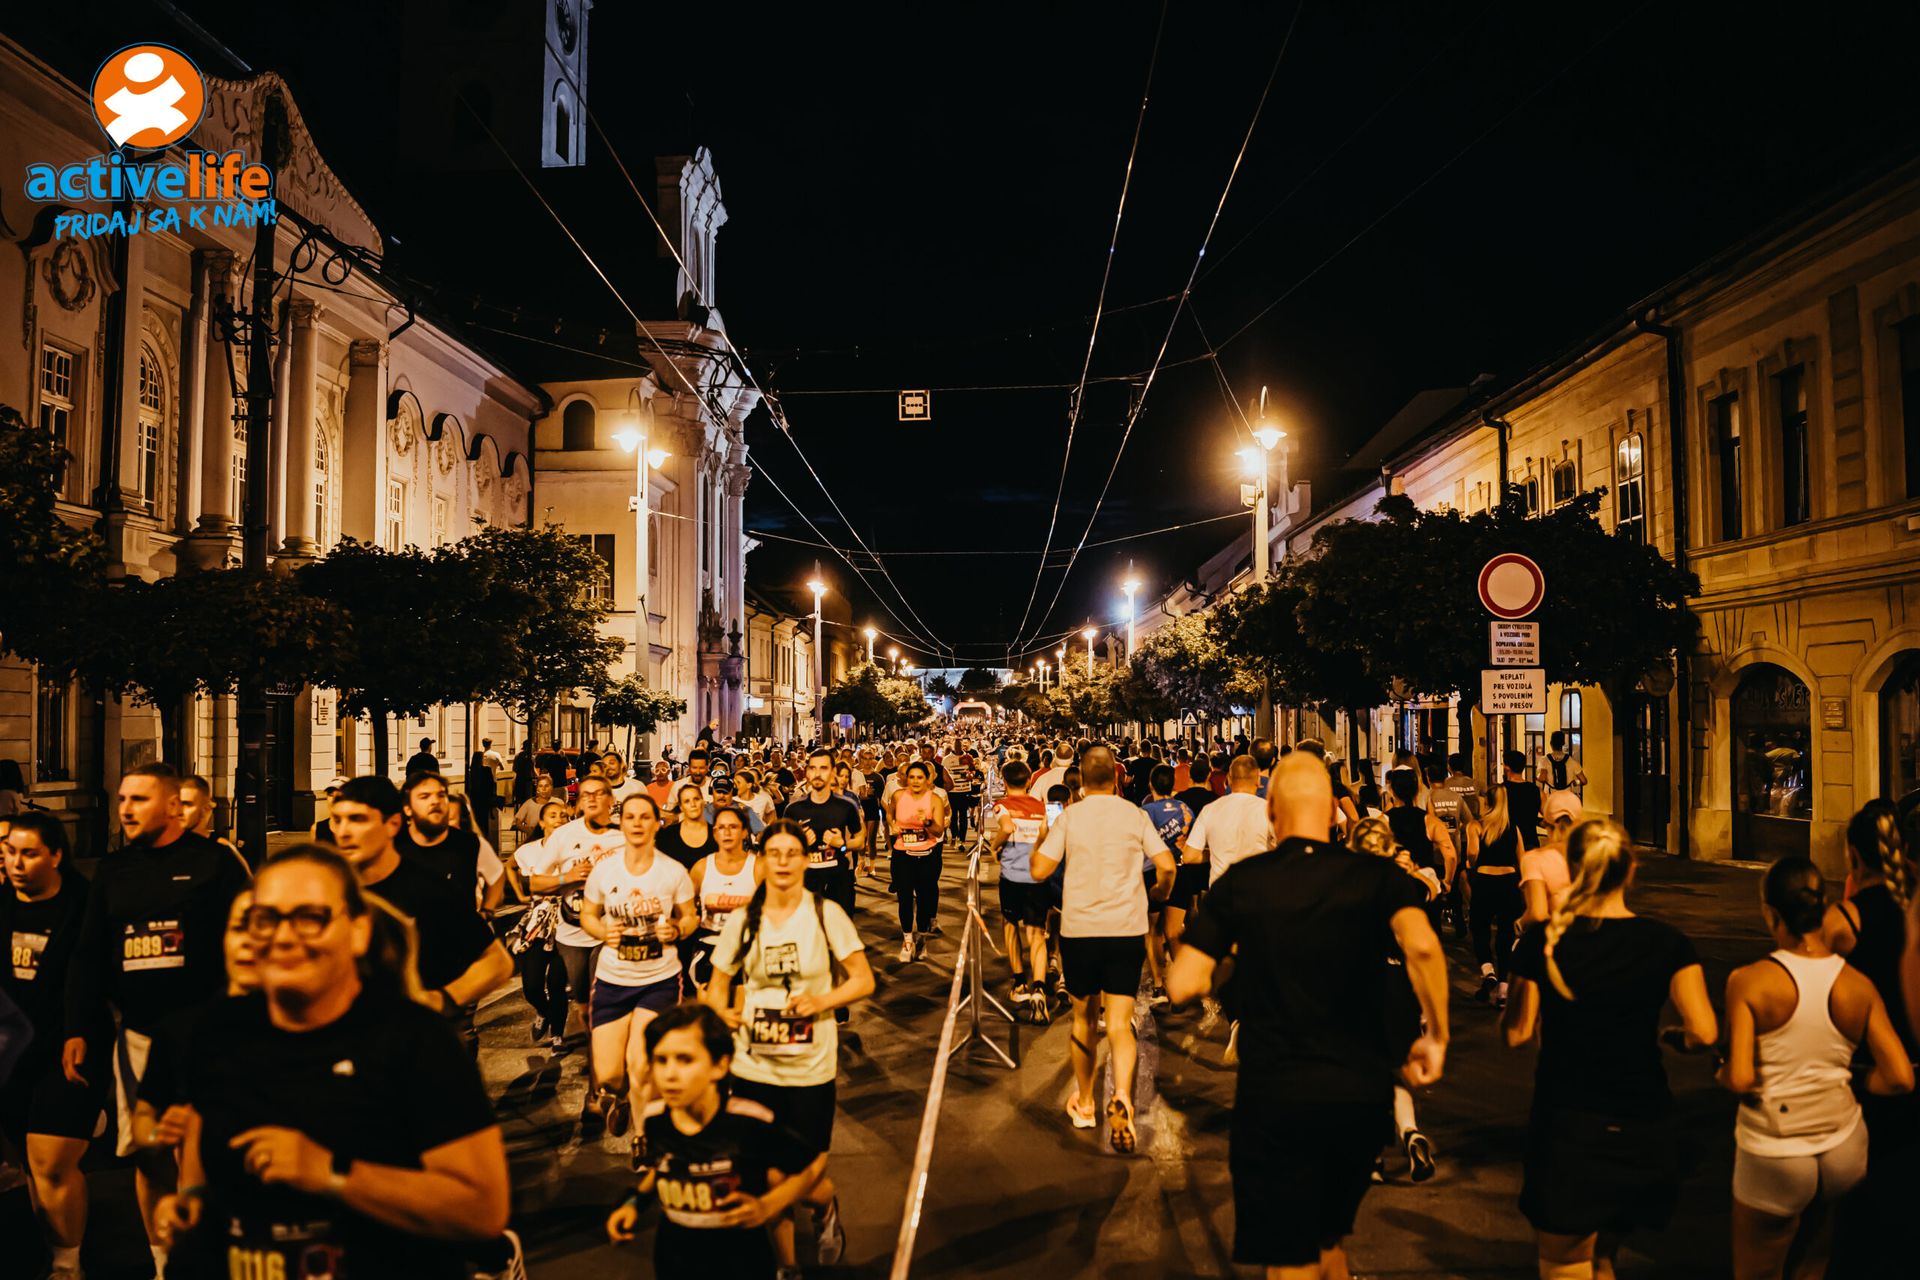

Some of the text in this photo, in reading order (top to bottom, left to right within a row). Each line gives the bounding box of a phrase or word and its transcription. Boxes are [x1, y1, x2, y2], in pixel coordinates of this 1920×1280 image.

[1500, 672, 1525, 680] NEPLATÍ
[1506, 682, 1532, 690] VOZIDLÁ
[1509, 701, 1534, 709] PREŠOV
[124, 935, 162, 959] 0689
[754, 1021, 791, 1043] 1542
